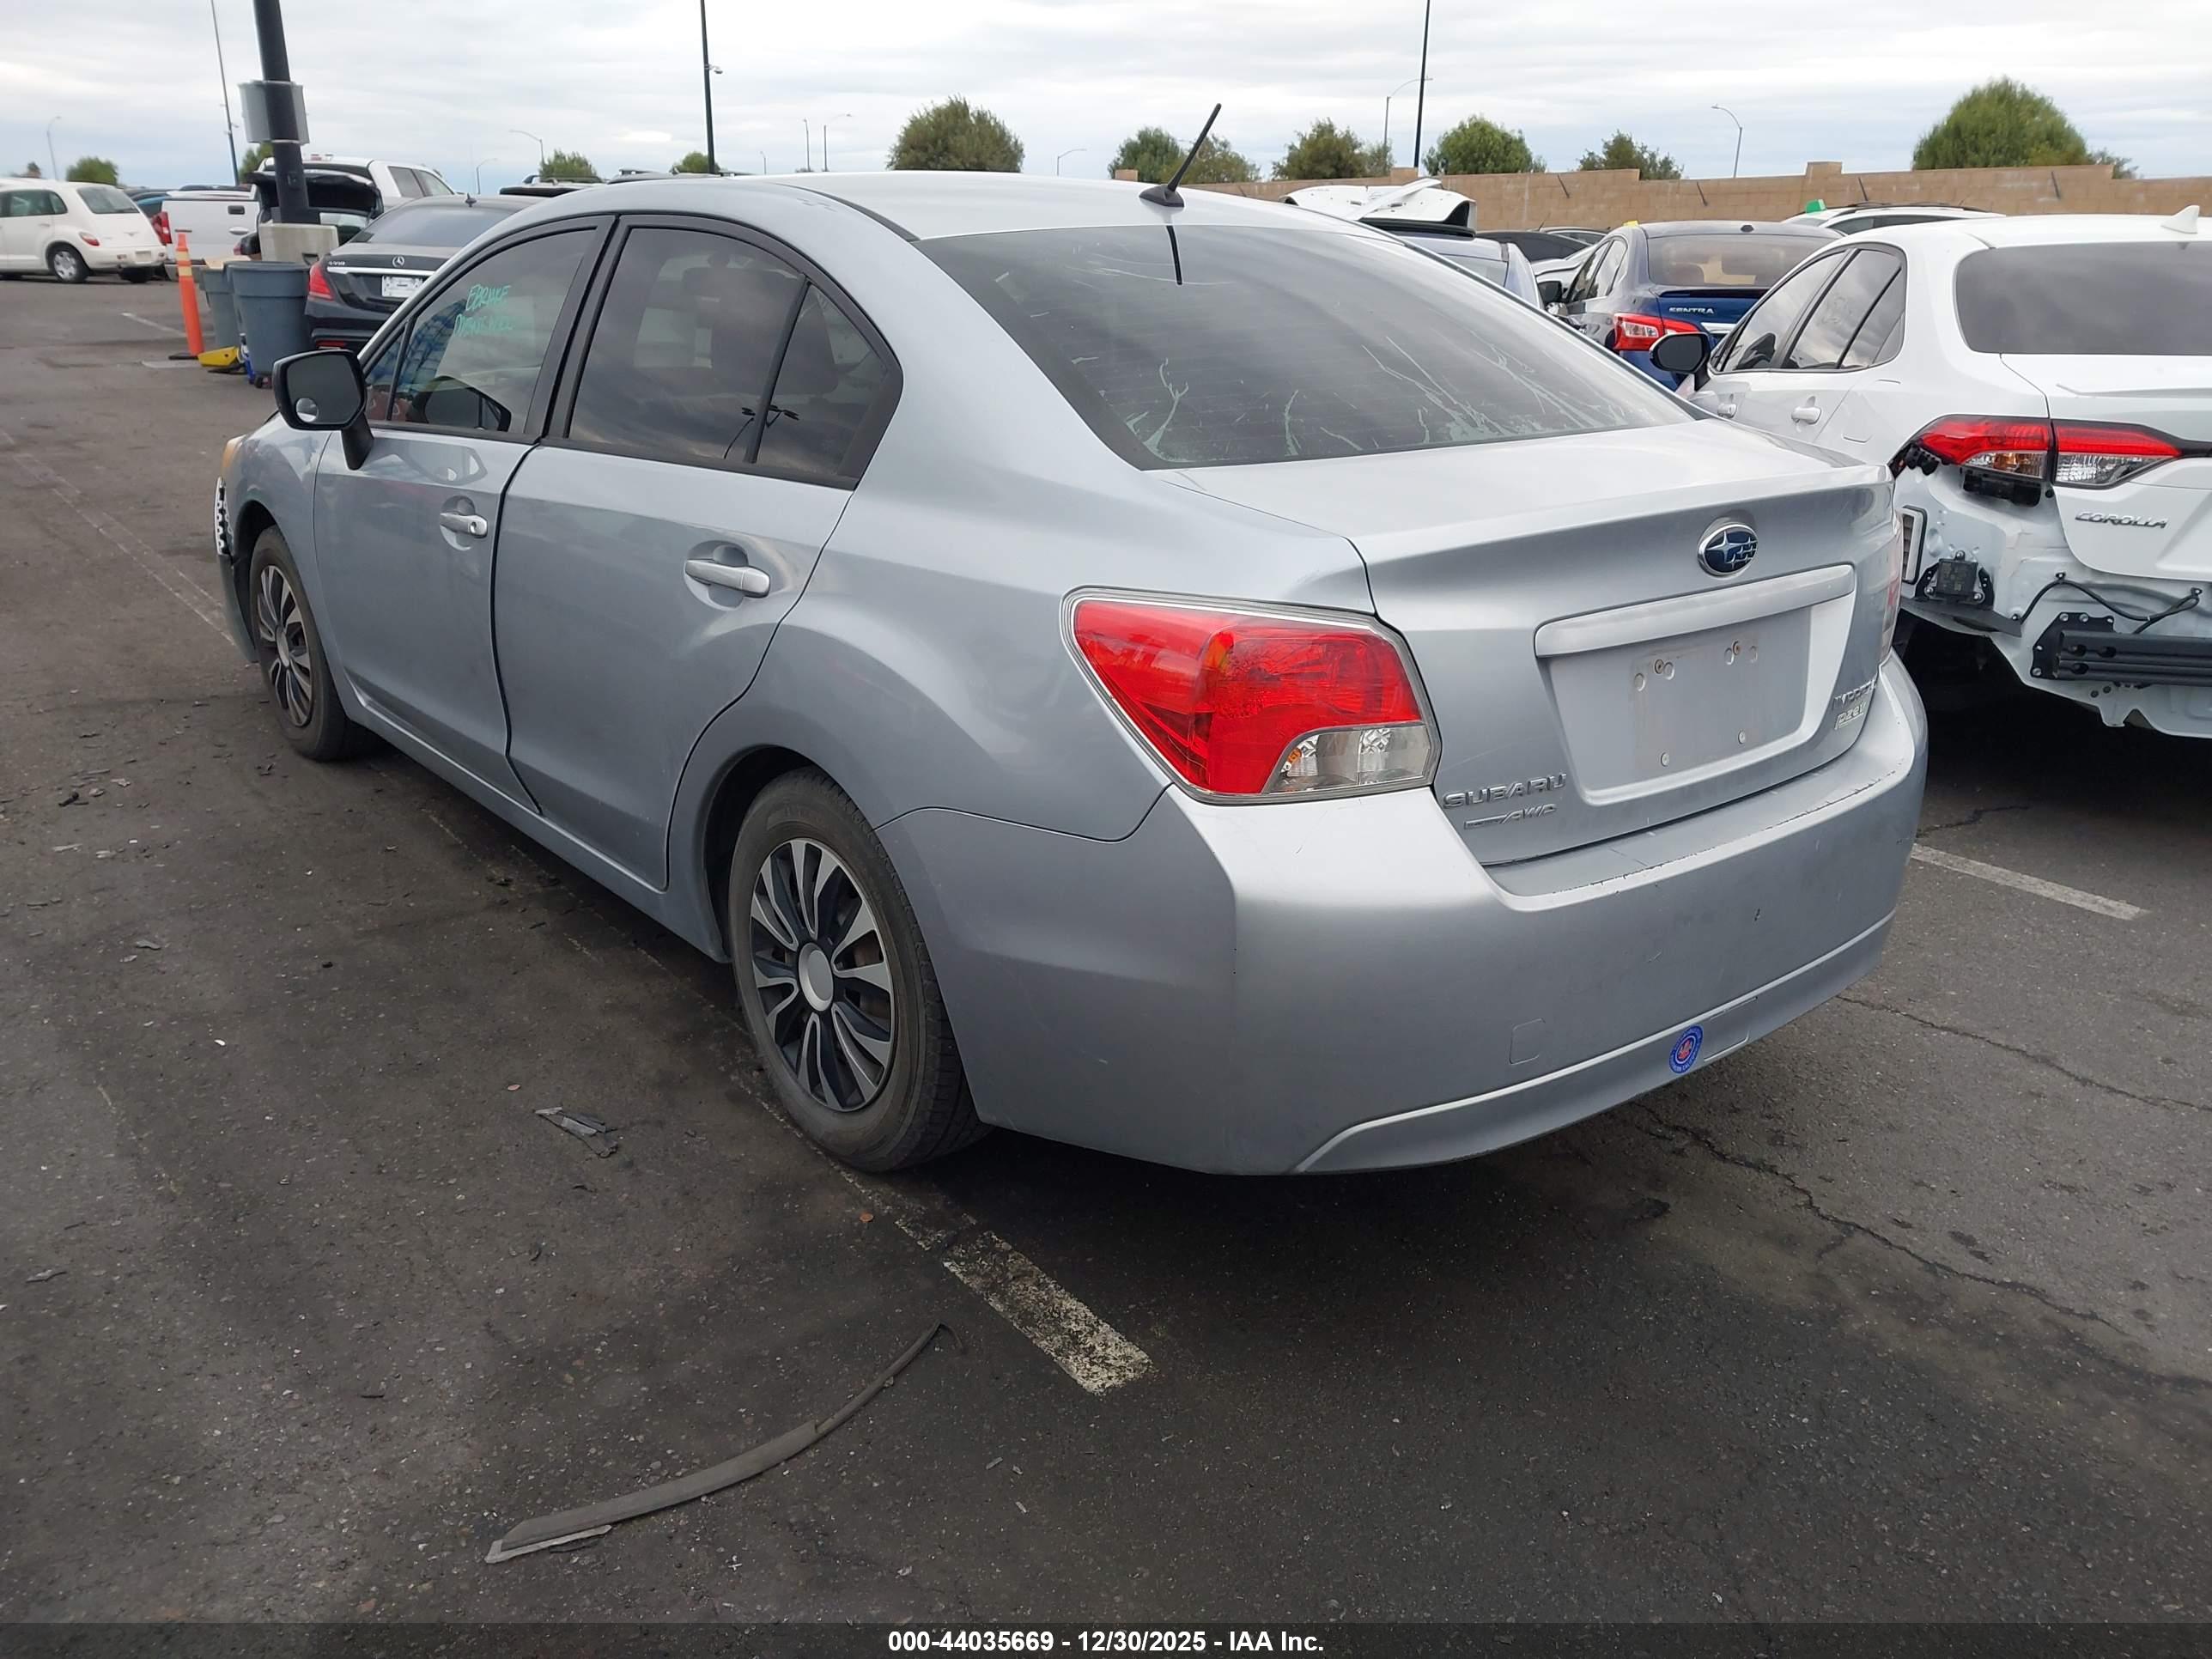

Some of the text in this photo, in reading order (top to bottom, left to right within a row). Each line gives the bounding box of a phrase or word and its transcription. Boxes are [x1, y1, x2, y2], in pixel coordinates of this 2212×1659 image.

[1668, 307, 1715, 315] SENTRA
[2075, 512, 2167, 528] COROLLA
[1443, 773, 1567, 809] SUBARU
